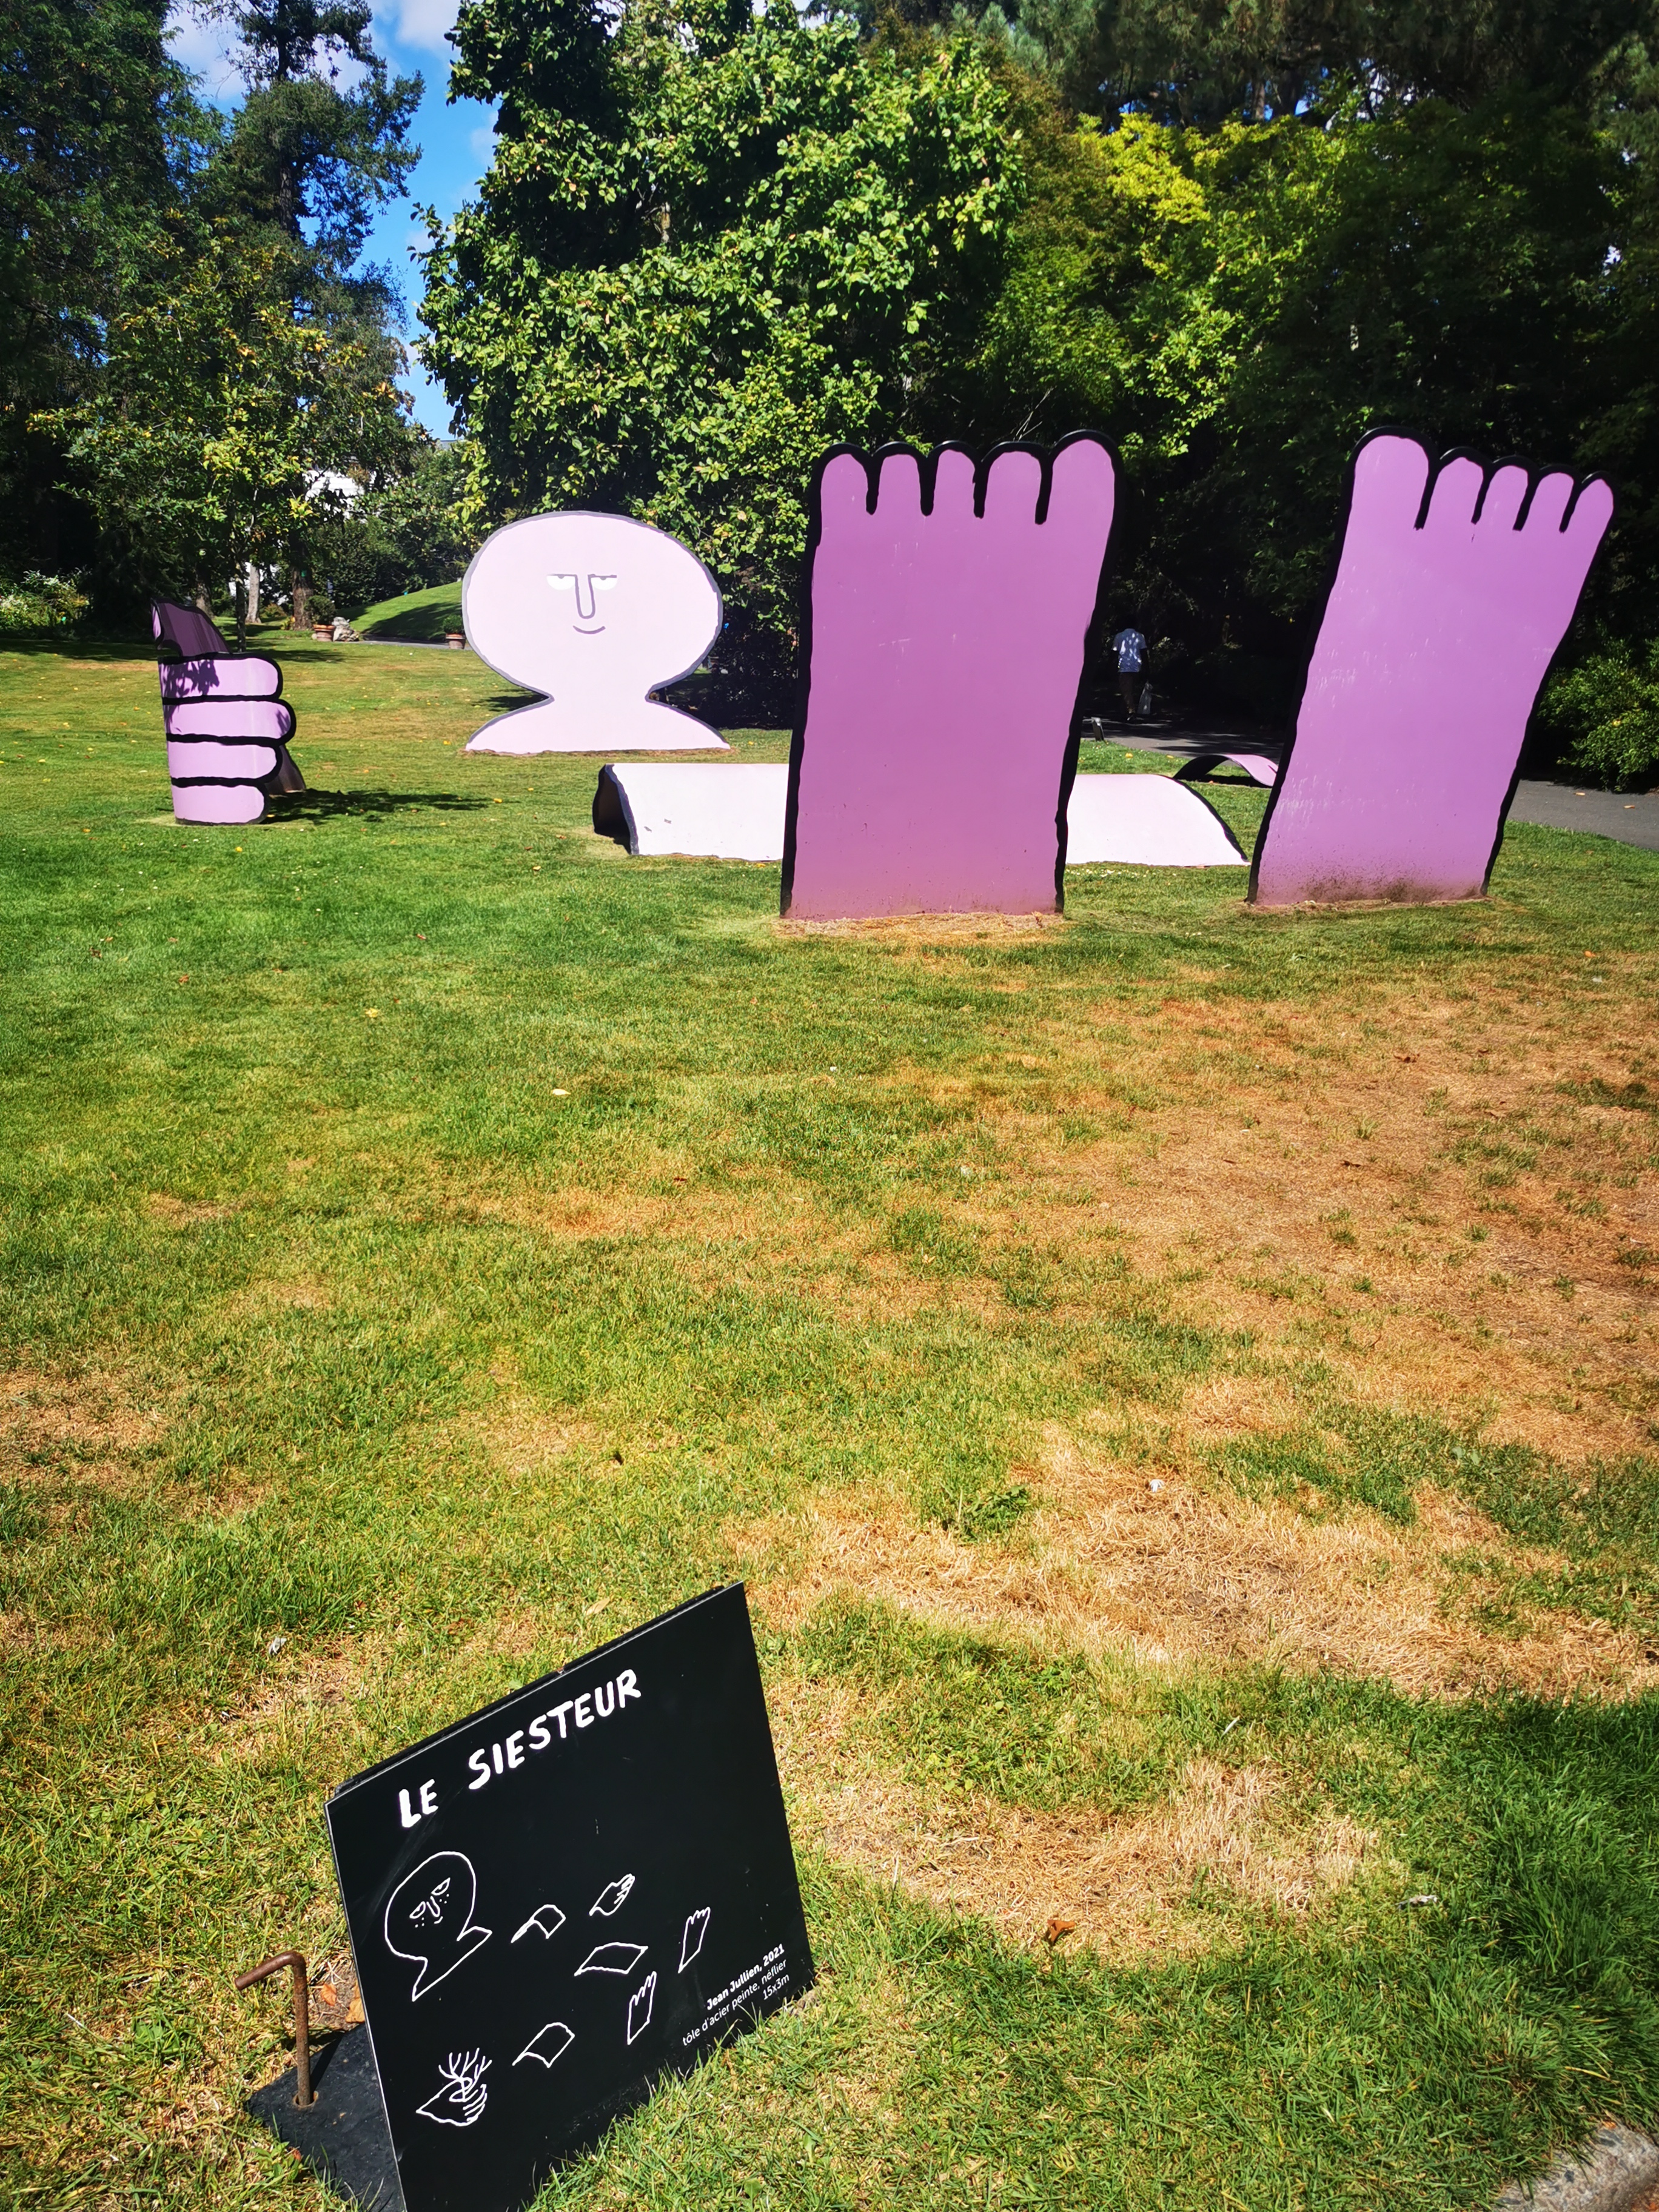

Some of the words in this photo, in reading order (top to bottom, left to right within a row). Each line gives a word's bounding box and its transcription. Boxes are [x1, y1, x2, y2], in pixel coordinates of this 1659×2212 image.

[399, 1778, 438, 1828] LE
[468, 1669, 642, 1789] SIESTEUR
[682, 2028, 700, 2046] tôle
[702, 2004, 730, 2031] d'acier
[731, 1982, 760, 2010] peinte,
[761, 1959, 787, 1985] néflier
[706, 1988, 729, 2010] Jean
[729, 1964, 762, 1992] Jullien,
[762, 1943, 785, 1966] 2021
[762, 1975, 790, 2000] 15x3m
